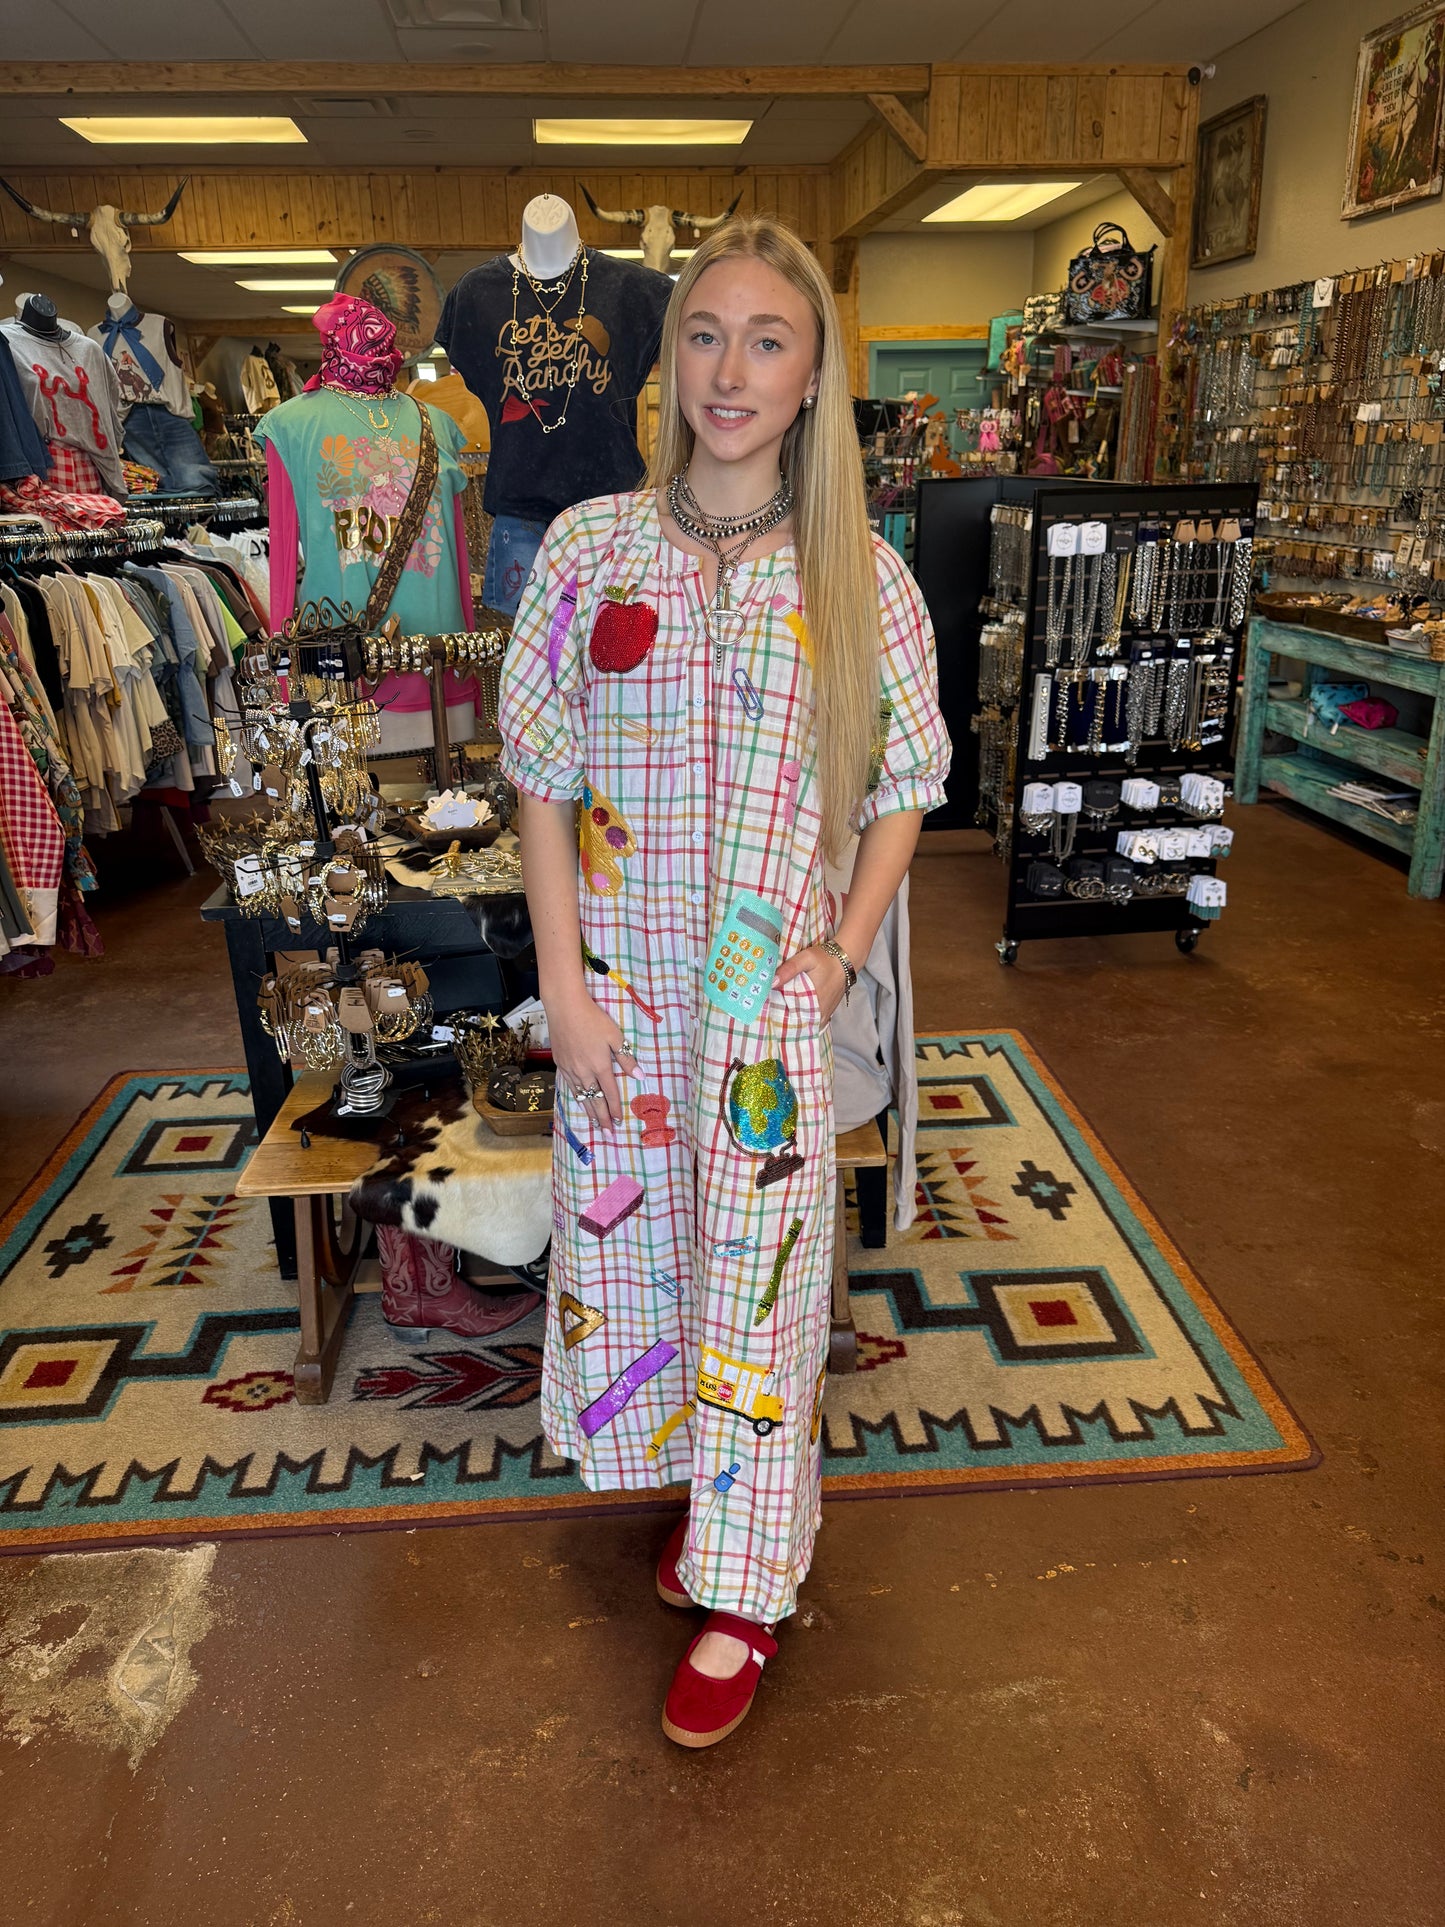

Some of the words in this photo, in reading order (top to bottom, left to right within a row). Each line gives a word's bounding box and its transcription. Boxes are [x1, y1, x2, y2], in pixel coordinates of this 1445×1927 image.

[494, 314, 565, 358] Let's
[527, 333, 583, 368] get
[499, 344, 612, 403] Ranchy
